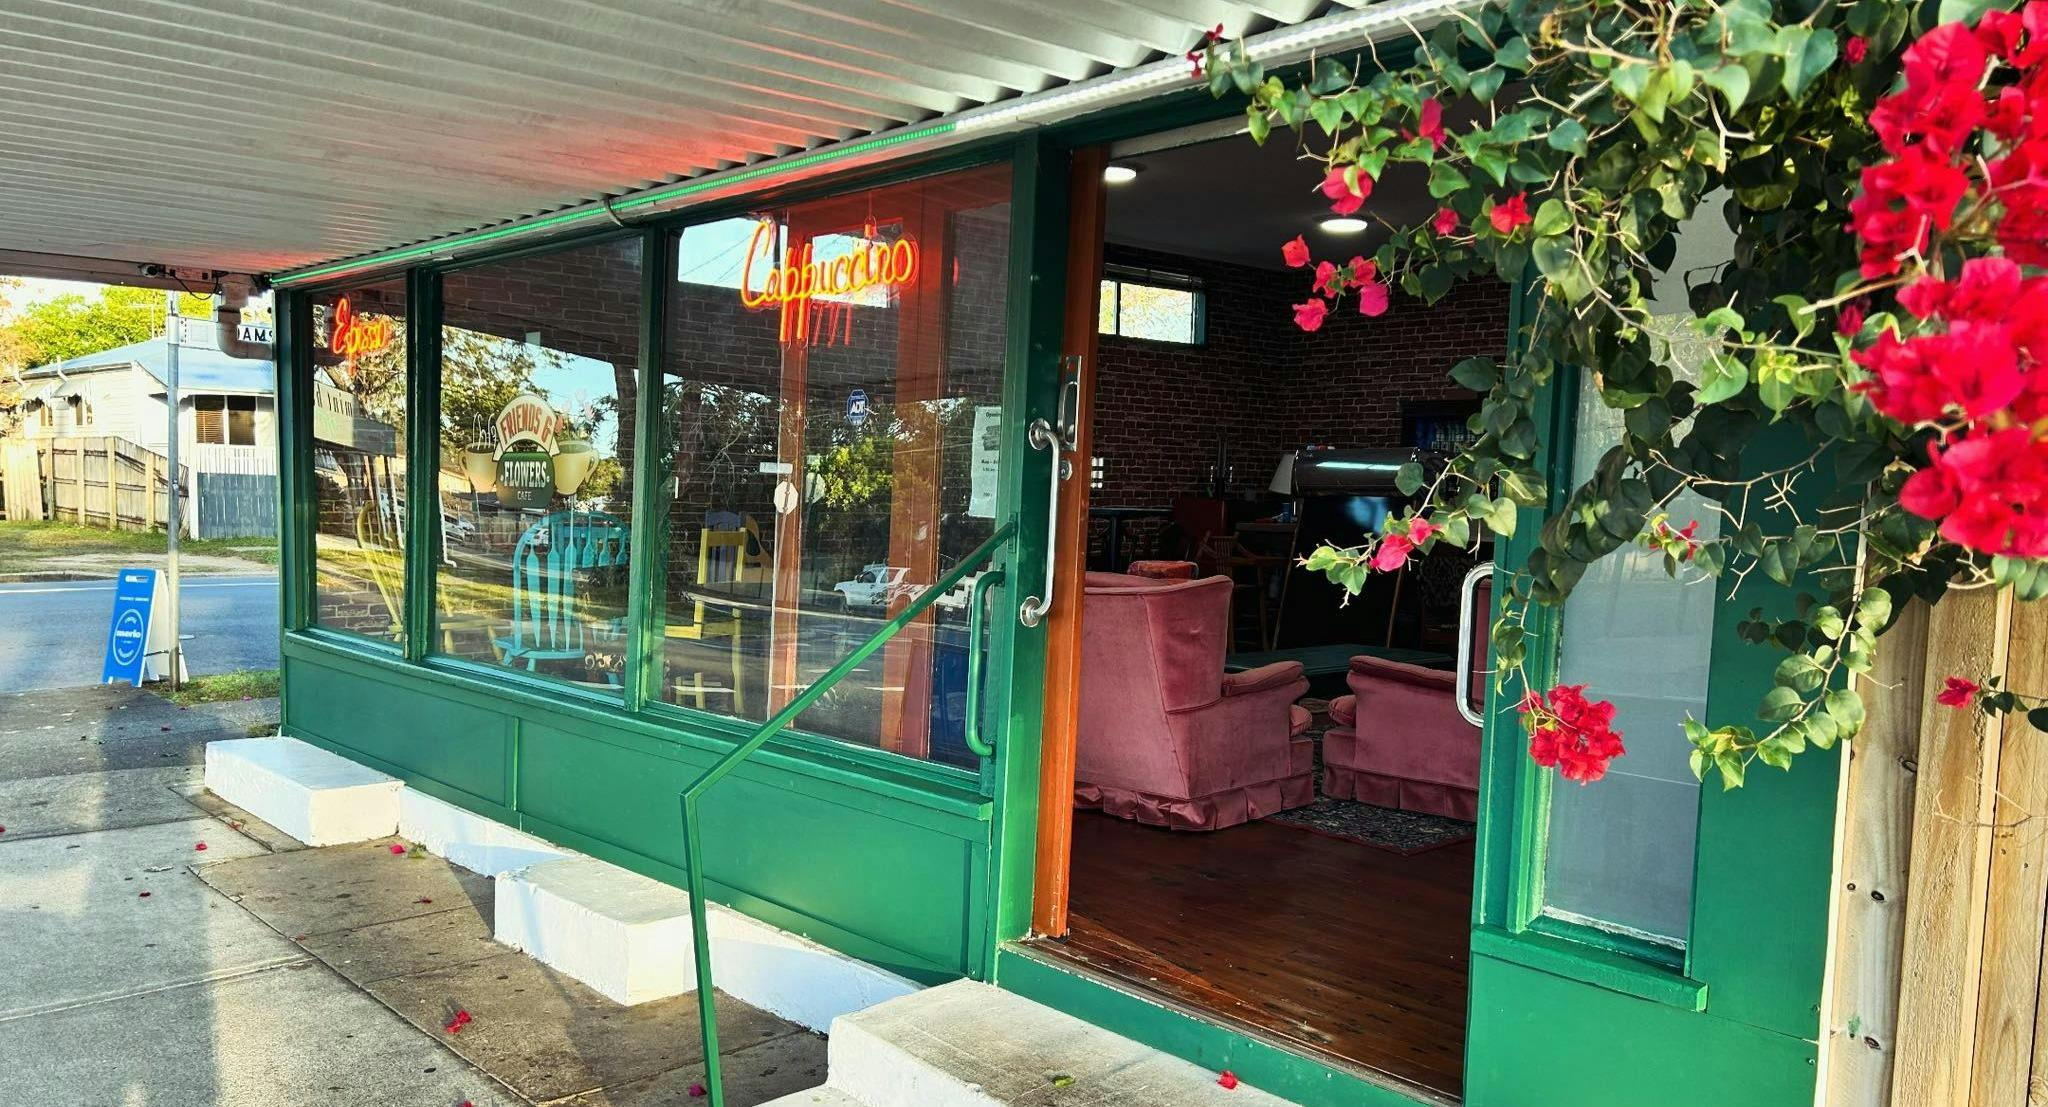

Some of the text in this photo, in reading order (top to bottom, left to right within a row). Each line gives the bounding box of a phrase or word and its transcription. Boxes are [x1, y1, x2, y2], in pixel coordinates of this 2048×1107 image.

[741, 220, 913, 342] Cappuccino
[237, 327, 273, 342] AM
[850, 400, 865, 414] ADT
[500, 402, 542, 444] FRIENDS
[504, 461, 547, 488] FLOWERS
[517, 490, 532, 501] CAFE
